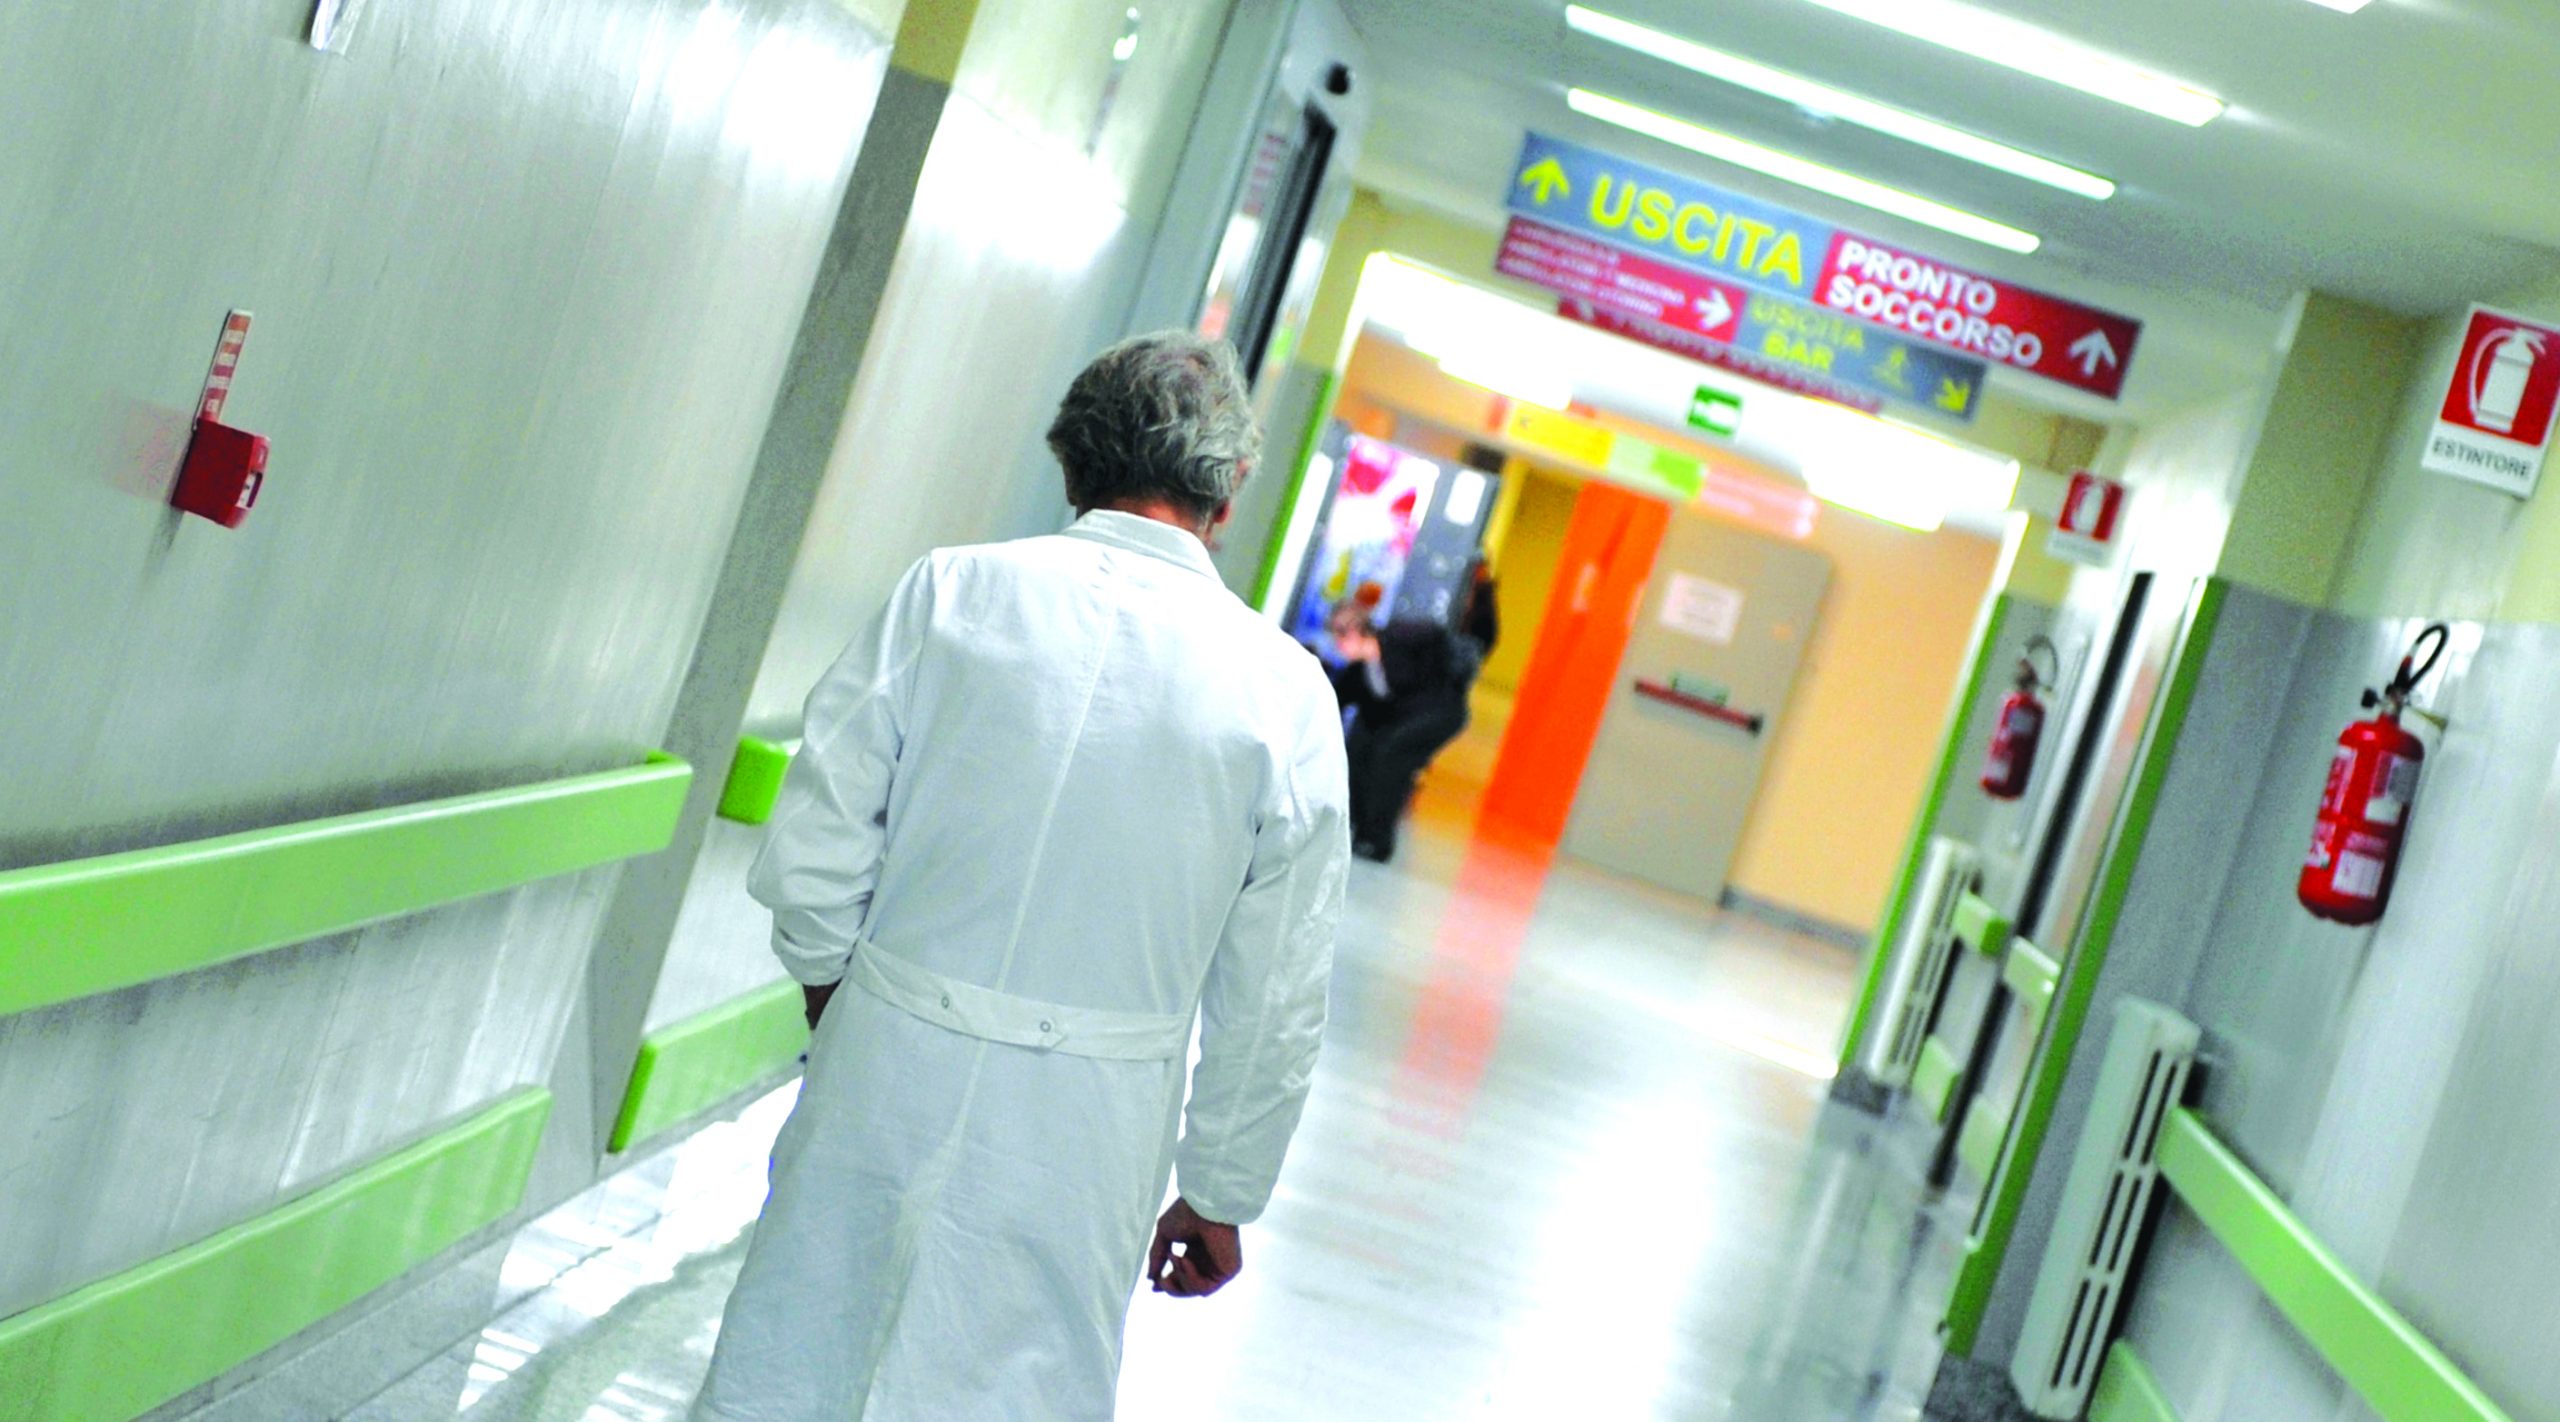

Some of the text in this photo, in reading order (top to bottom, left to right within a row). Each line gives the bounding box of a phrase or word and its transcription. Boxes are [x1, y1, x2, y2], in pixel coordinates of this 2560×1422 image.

[1589, 175, 1805, 287] USCITA
[1836, 238, 1998, 317] PRONTO
[1751, 297, 1865, 353] USCITA
[1764, 331, 1834, 373] BAR
[1826, 274, 2044, 368] SOCCORSO
[2432, 437, 2532, 480] ESTINTORE
